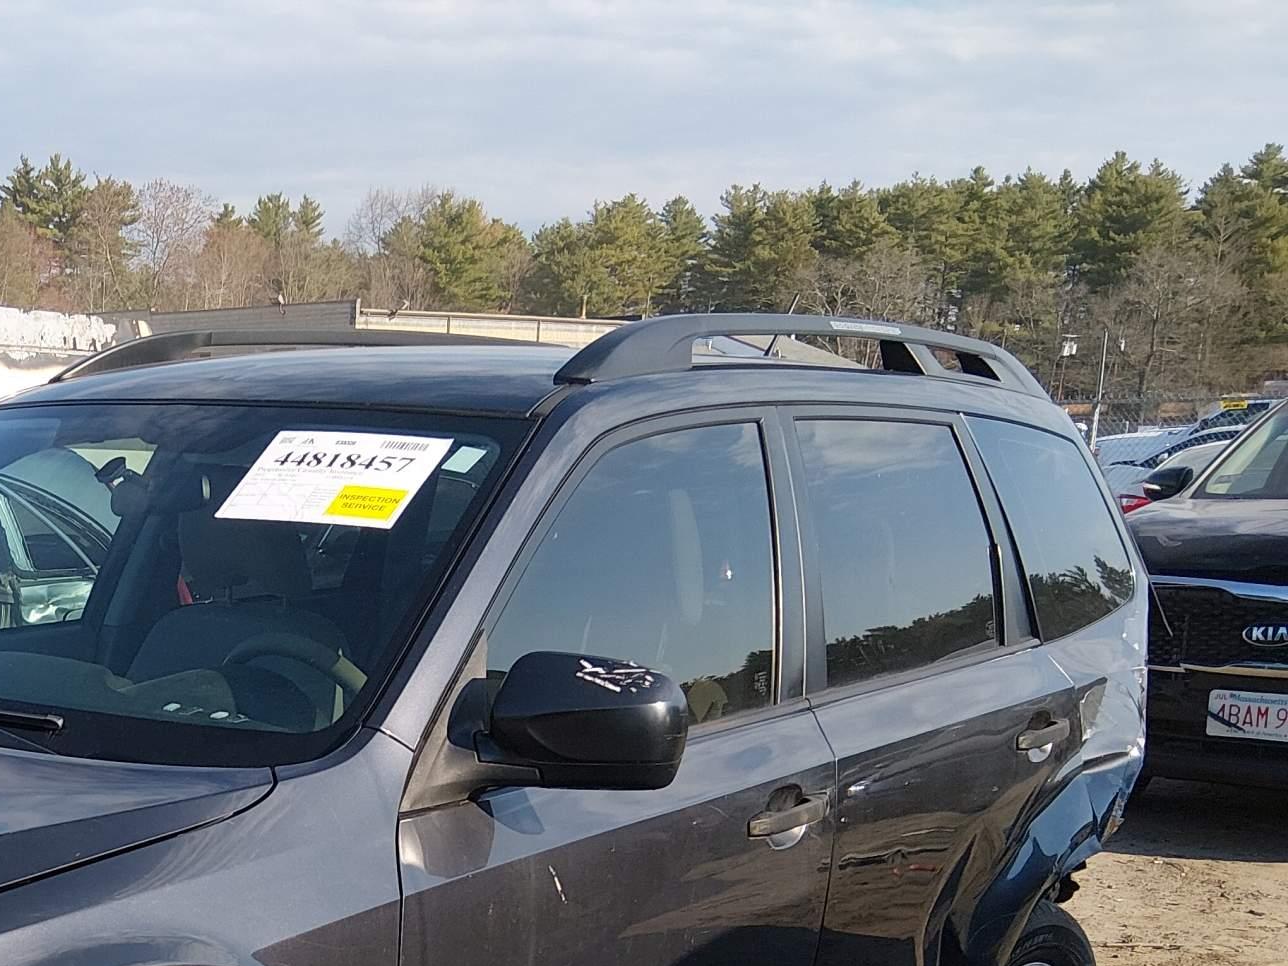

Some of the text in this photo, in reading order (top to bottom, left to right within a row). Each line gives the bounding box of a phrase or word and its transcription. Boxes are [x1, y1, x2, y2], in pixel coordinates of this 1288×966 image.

[274, 451, 416, 472] 44818457
[339, 493, 401, 505] INSPECTION
[341, 502, 387, 512] SERVICE
[1252, 626, 1288, 641] KIA
